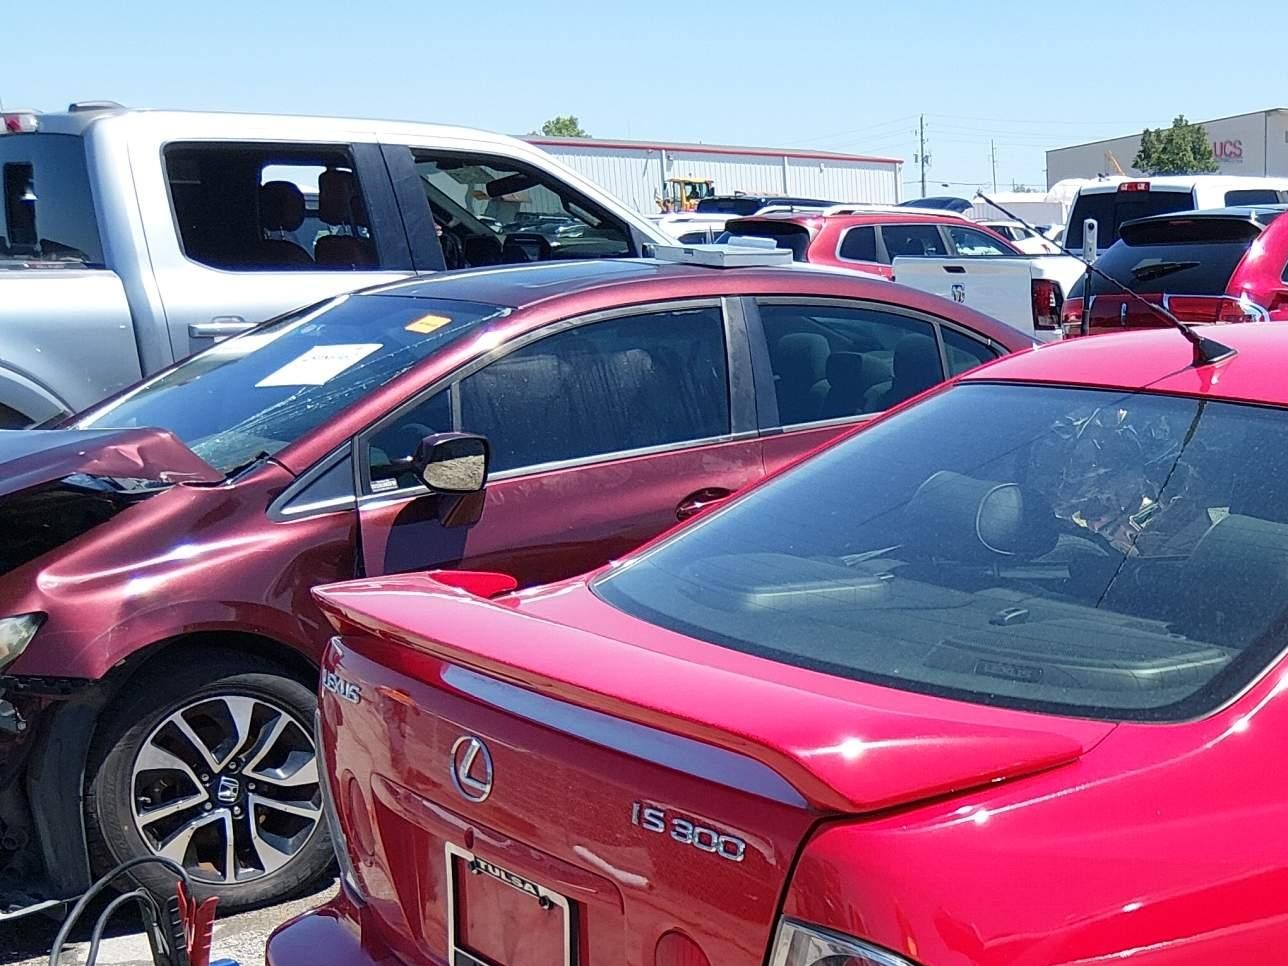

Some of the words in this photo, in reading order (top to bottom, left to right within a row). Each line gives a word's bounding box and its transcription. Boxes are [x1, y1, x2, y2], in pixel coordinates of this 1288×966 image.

[1213, 139, 1243, 158] UCS
[321, 668, 360, 704] LEXUS
[631, 800, 666, 833] IS
[670, 813, 746, 863] 300
[478, 860, 538, 895] TULSA
